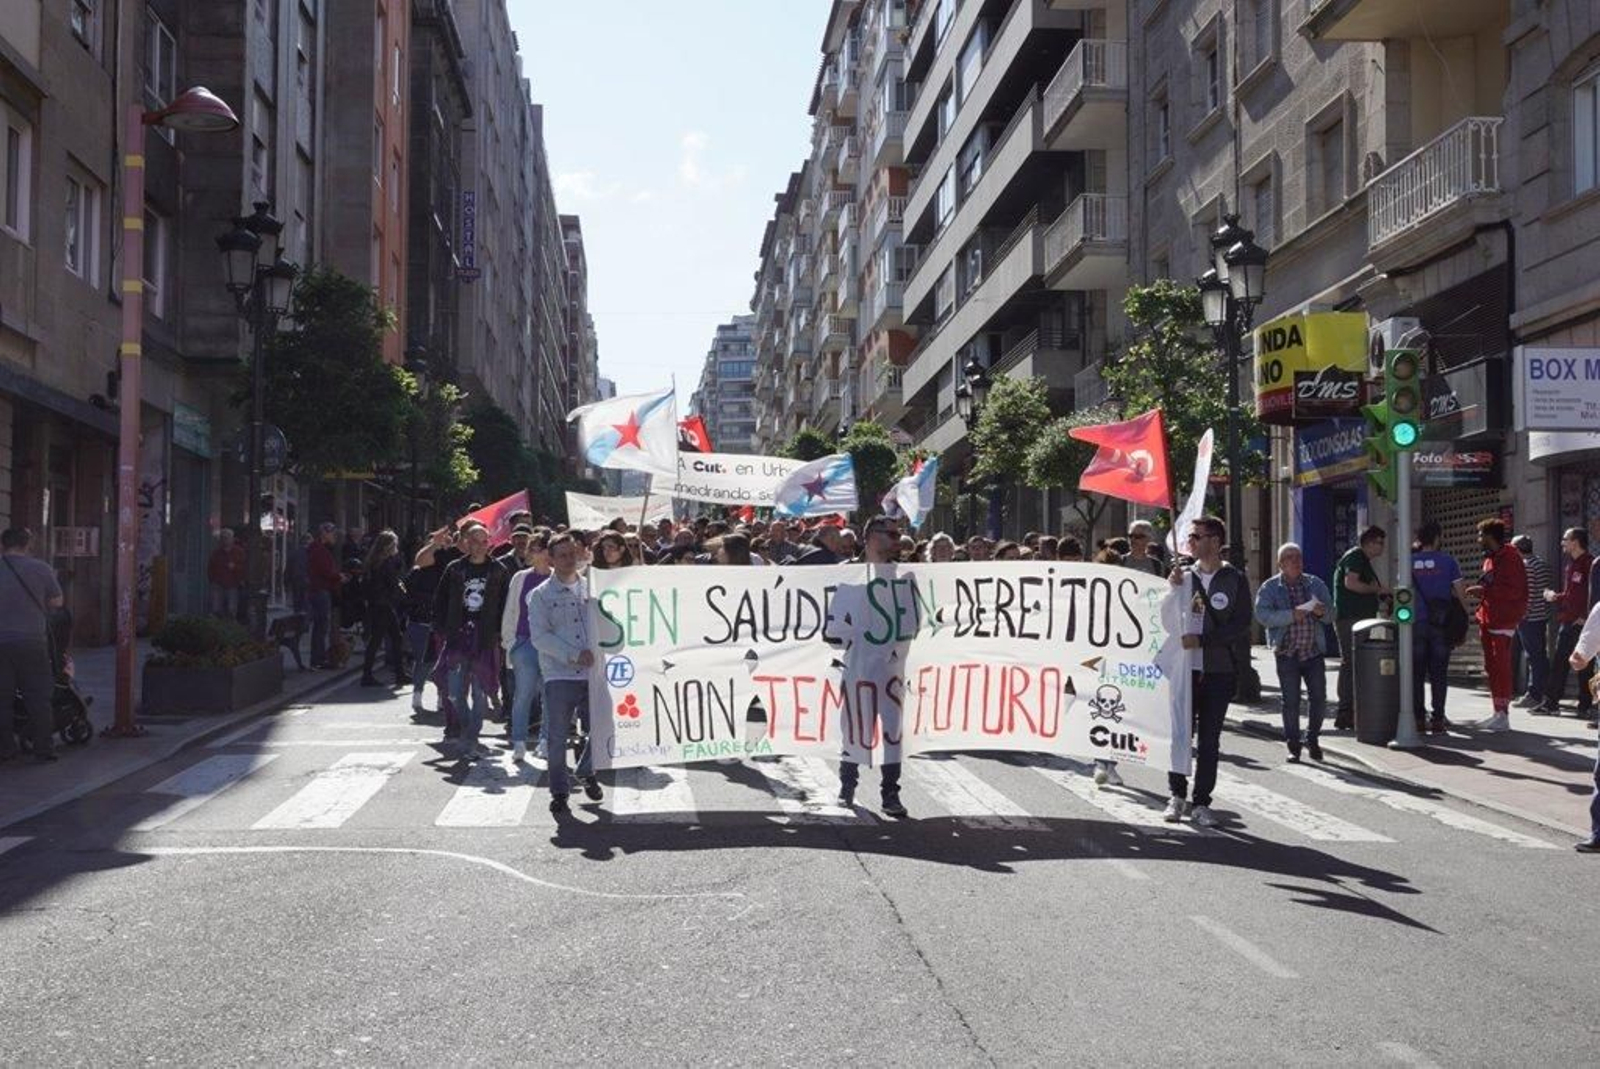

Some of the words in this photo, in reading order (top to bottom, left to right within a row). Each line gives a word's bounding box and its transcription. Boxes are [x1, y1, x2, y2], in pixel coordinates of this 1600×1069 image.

[463, 193, 475, 267] HOSTAL
[1530, 358, 1577, 380] BOX
[735, 465, 754, 475] en
[762, 462, 790, 477] Urb
[674, 483, 751, 500] medrando
[598, 587, 678, 648] SEN
[863, 576, 939, 646] SEN
[954, 568, 1143, 649] DEREITOS
[1118, 661, 1164, 680] DENSO
[653, 677, 736, 746] NON
[752, 675, 902, 750] TEMOS
[913, 663, 1061, 738] FUTURO
[683, 739, 773, 759] FAURECIA
